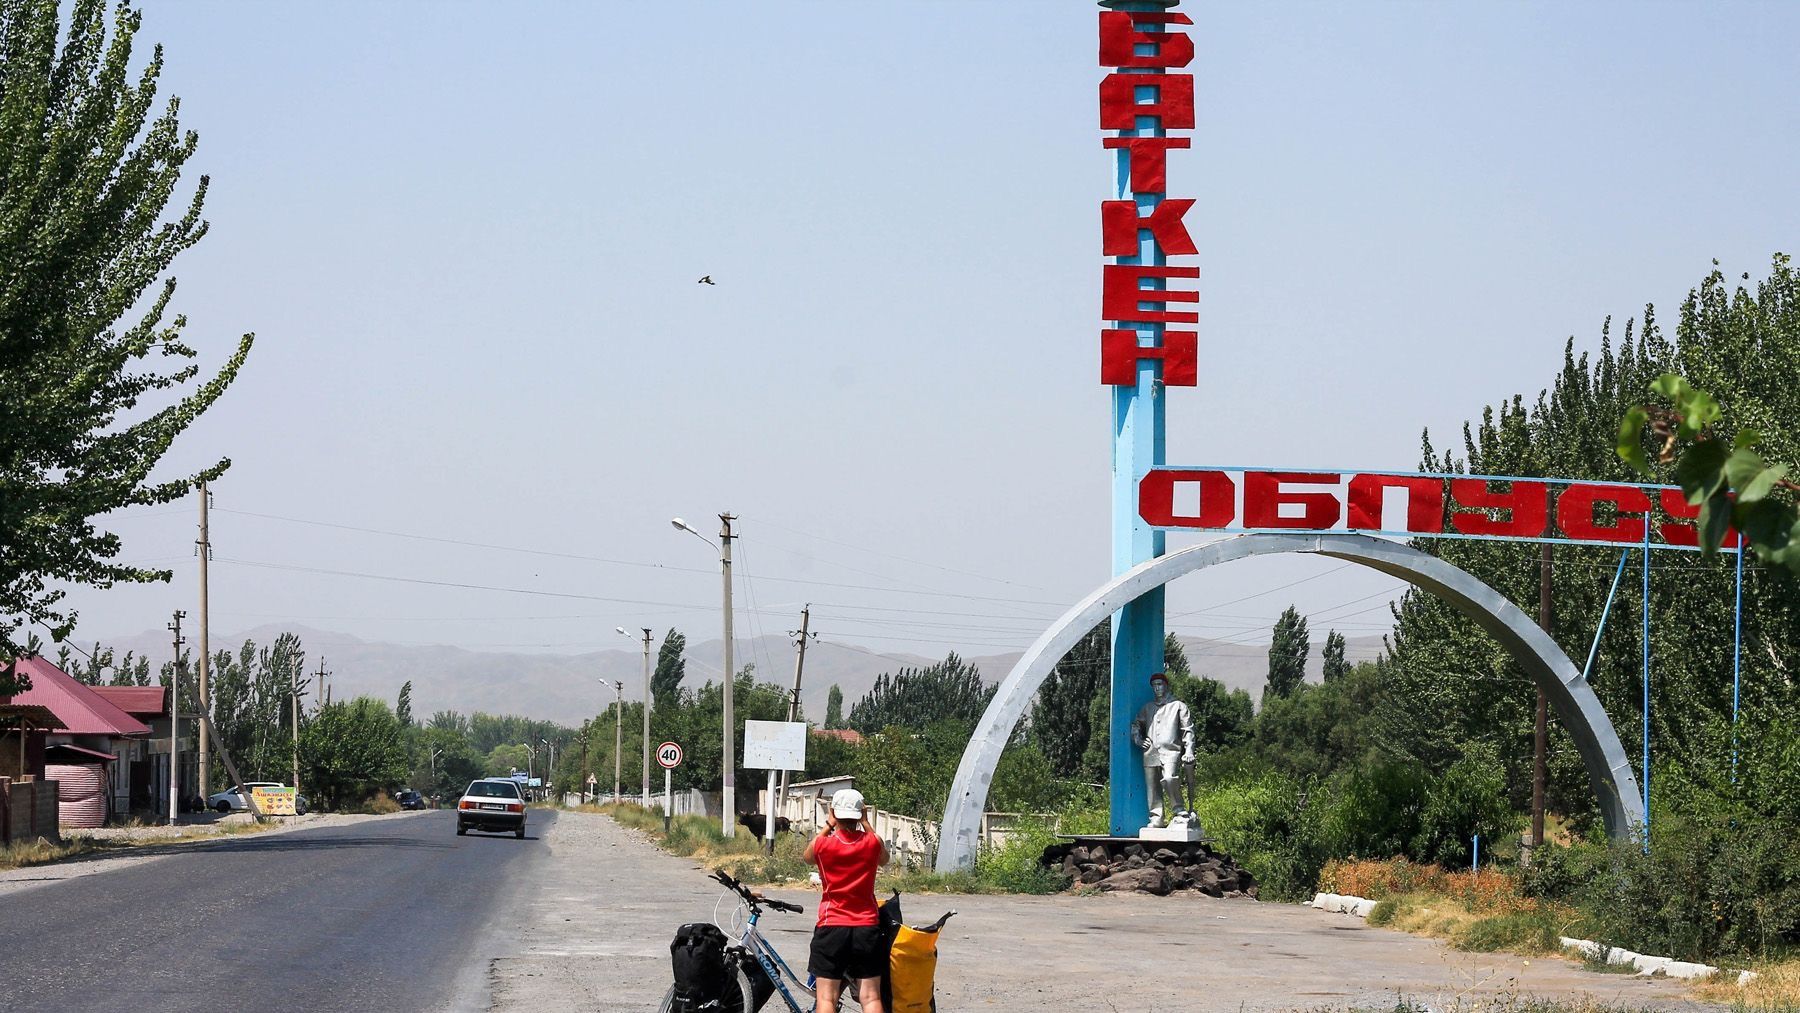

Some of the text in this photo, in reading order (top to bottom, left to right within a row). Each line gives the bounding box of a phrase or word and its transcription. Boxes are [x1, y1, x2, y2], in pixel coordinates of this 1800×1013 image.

[1099, 11, 1199, 386] БАТКЕН
[661, 749, 677, 761] 40
[758, 951, 788, 992] ROMET
